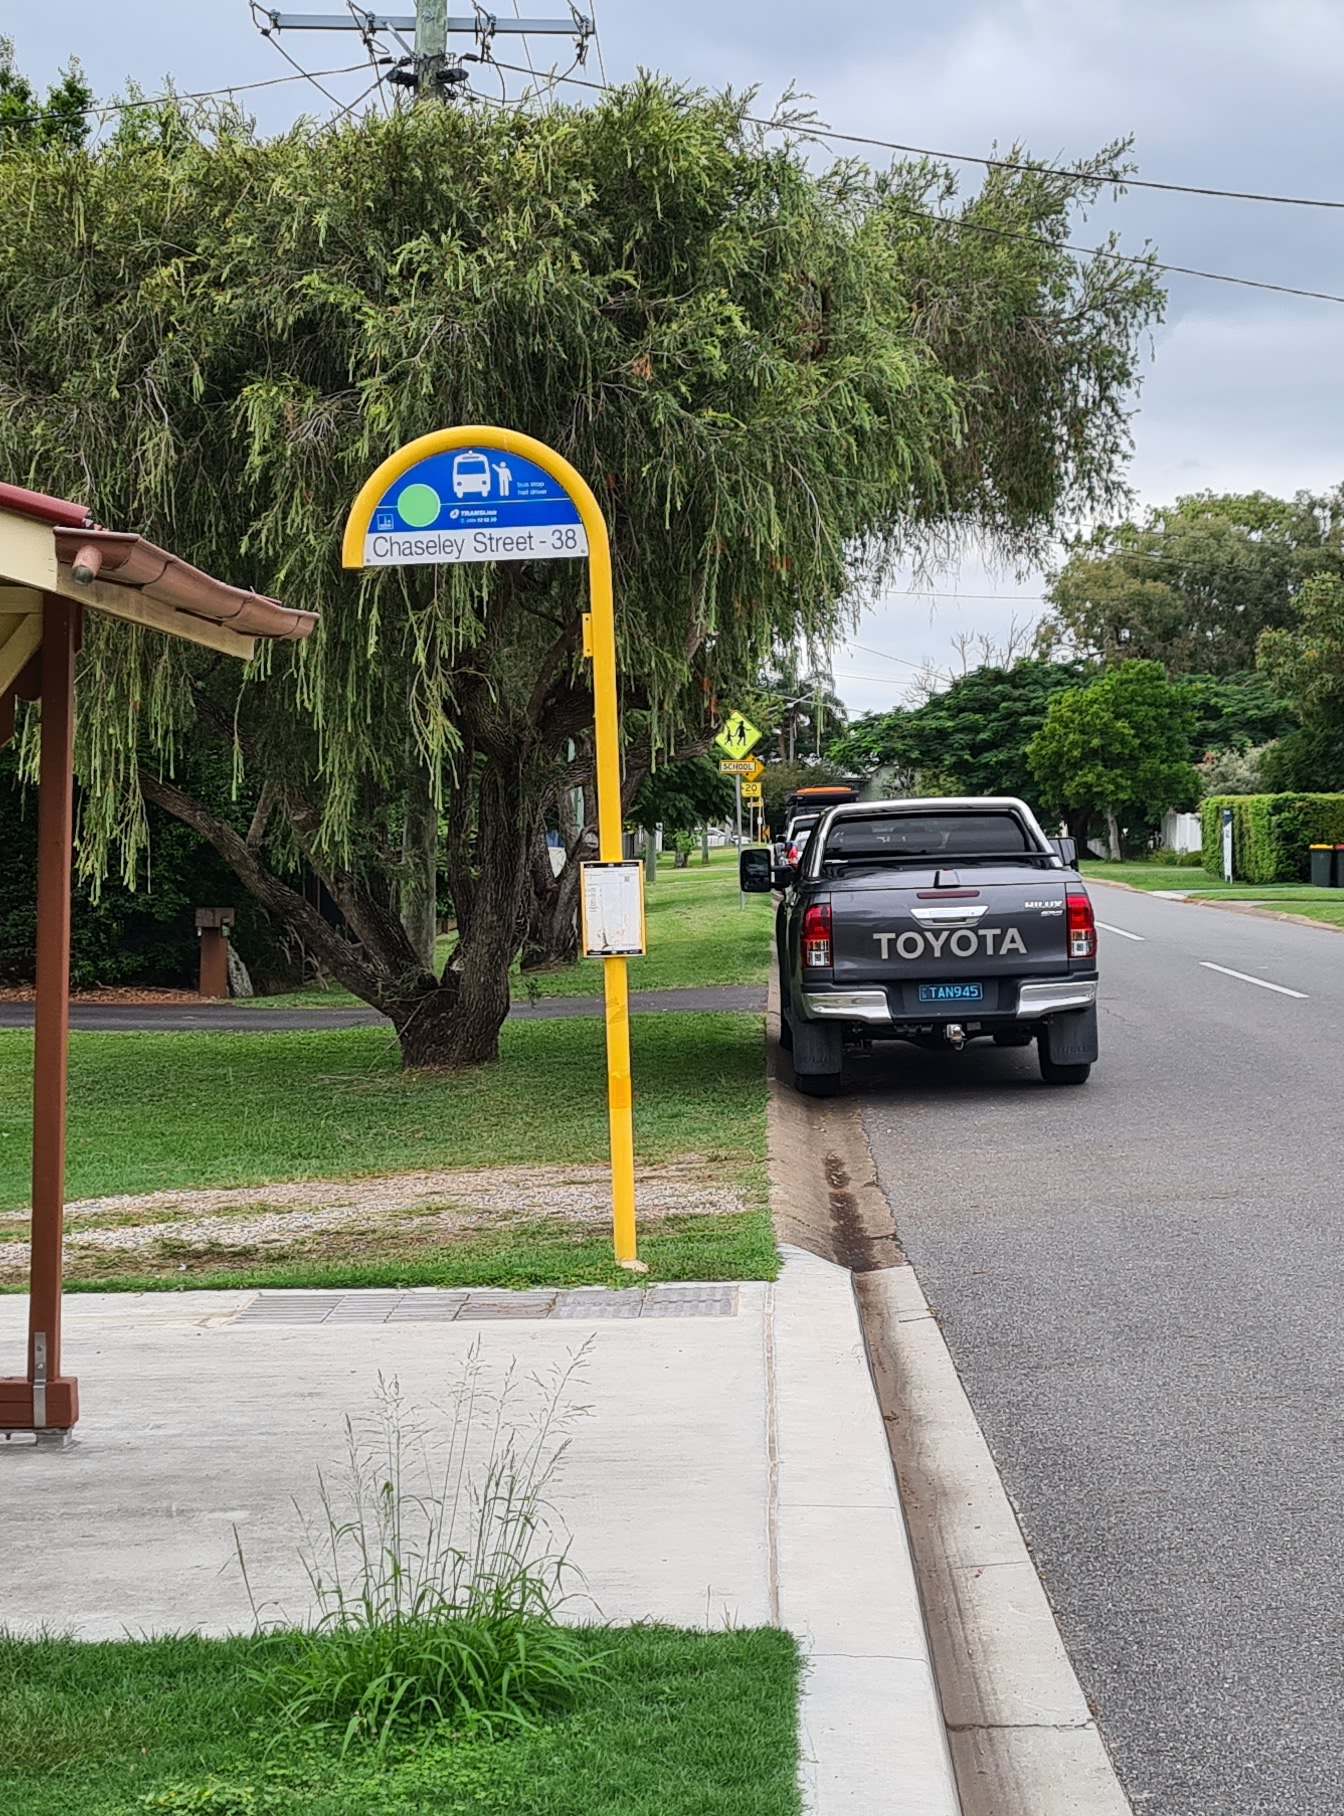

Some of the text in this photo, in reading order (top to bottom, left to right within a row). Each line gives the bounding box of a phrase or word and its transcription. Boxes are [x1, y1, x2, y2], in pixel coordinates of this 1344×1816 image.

[372, 534, 465, 559] Chaseley
[473, 531, 534, 553] Street
[551, 528, 577, 550] 38
[1024, 900, 1063, 908] HILUX
[872, 927, 1028, 960] TOYOTA
[929, 985, 979, 998] TAN945
